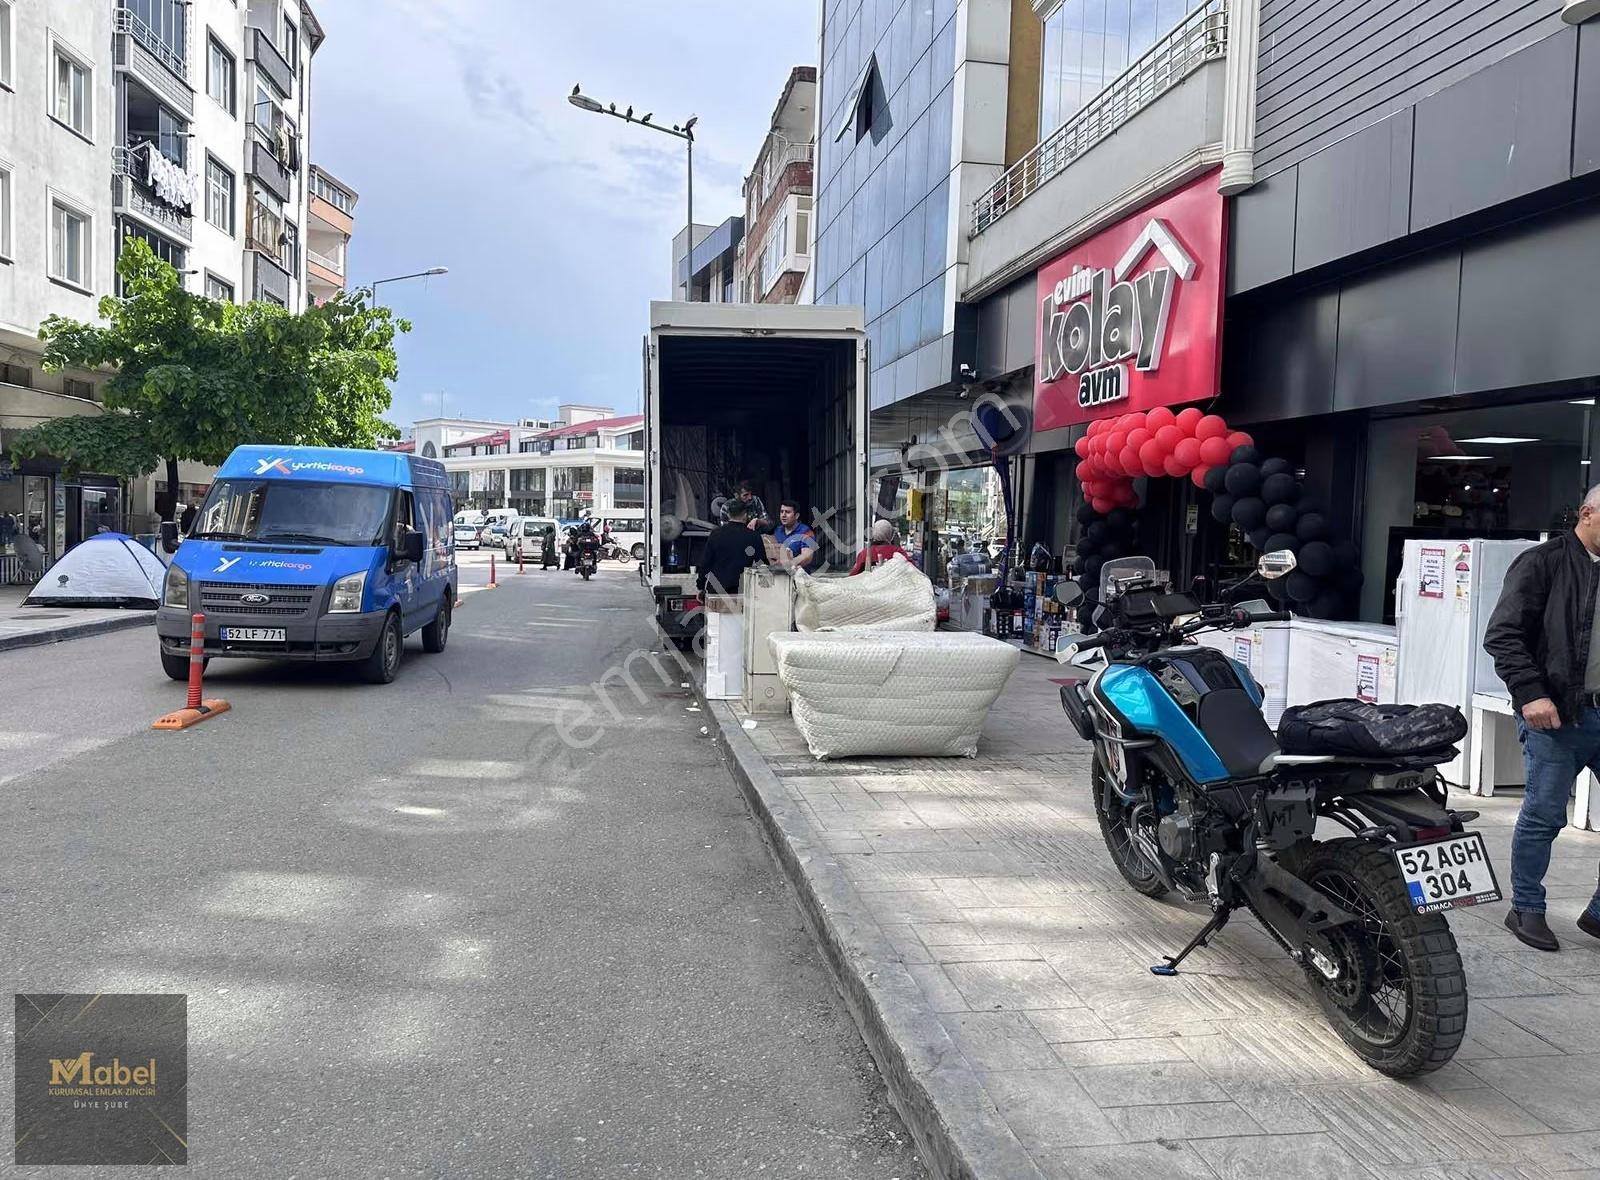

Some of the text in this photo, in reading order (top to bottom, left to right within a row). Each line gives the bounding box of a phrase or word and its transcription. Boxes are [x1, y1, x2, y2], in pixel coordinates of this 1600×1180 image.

[1054, 266, 1092, 303] evim
[1040, 267, 1176, 384] kolay
[1078, 365, 1128, 408] avm
[228, 629, 282, 640] 52 LF 771
[1401, 839, 1482, 875] 52 AGH
[1413, 896, 1425, 905] TR
[1426, 869, 1472, 899] 304
[1426, 901, 1453, 913] ATMACA
